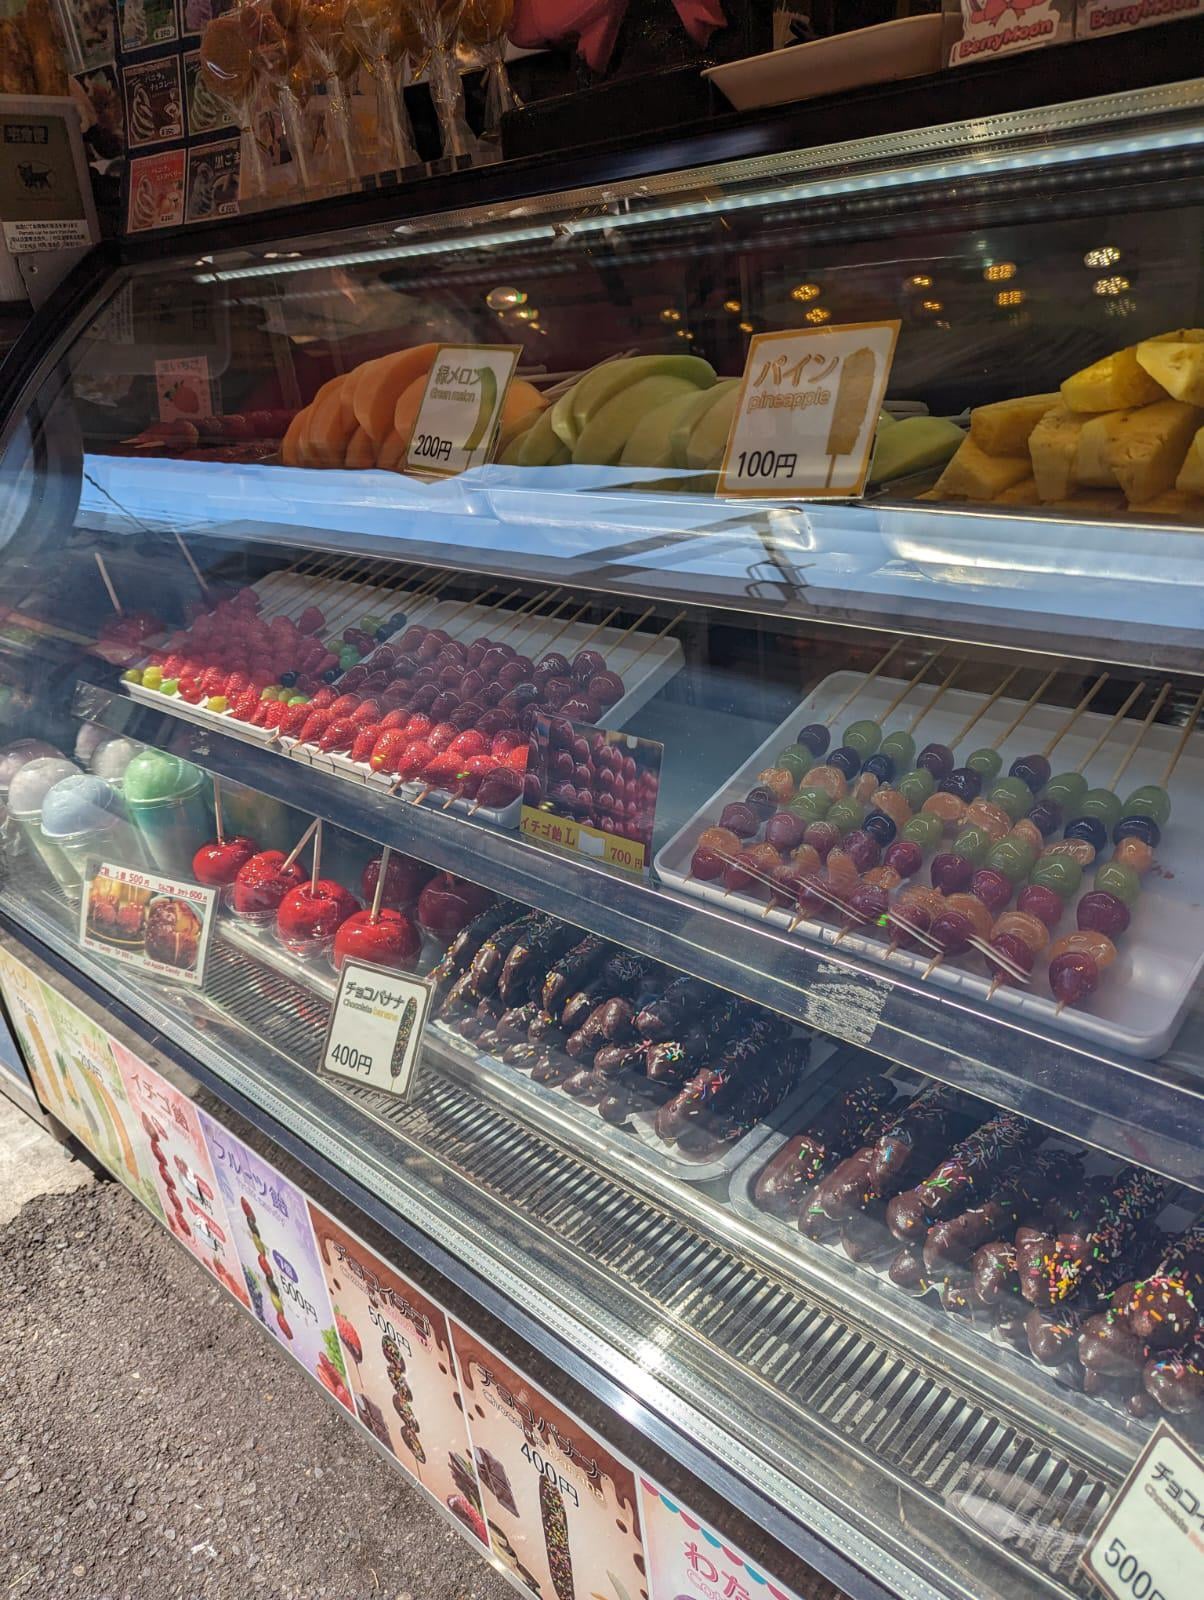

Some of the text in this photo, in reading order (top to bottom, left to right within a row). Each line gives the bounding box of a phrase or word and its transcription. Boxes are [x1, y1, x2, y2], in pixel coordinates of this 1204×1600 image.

[959, 18, 1054, 59] BerryMoon
[752, 353, 839, 388] パイン
[746, 386, 832, 415] pineapple
[414, 434, 453, 462] 200円
[737, 450, 798, 479] 100円
[345, 981, 405, 1010] チョコバナナ
[331, 1043, 373, 1076] 400円
[131, 1074, 190, 1133] イチゴ飴
[212, 1136, 289, 1219] フルーツ飴
[280, 1275, 319, 1324] 500円
[368, 1304, 412, 1358] 500円
[476, 1362, 609, 1481] チョコバナナ
[521, 1442, 579, 1508] 400円
[1104, 1537, 1166, 1600] 500
